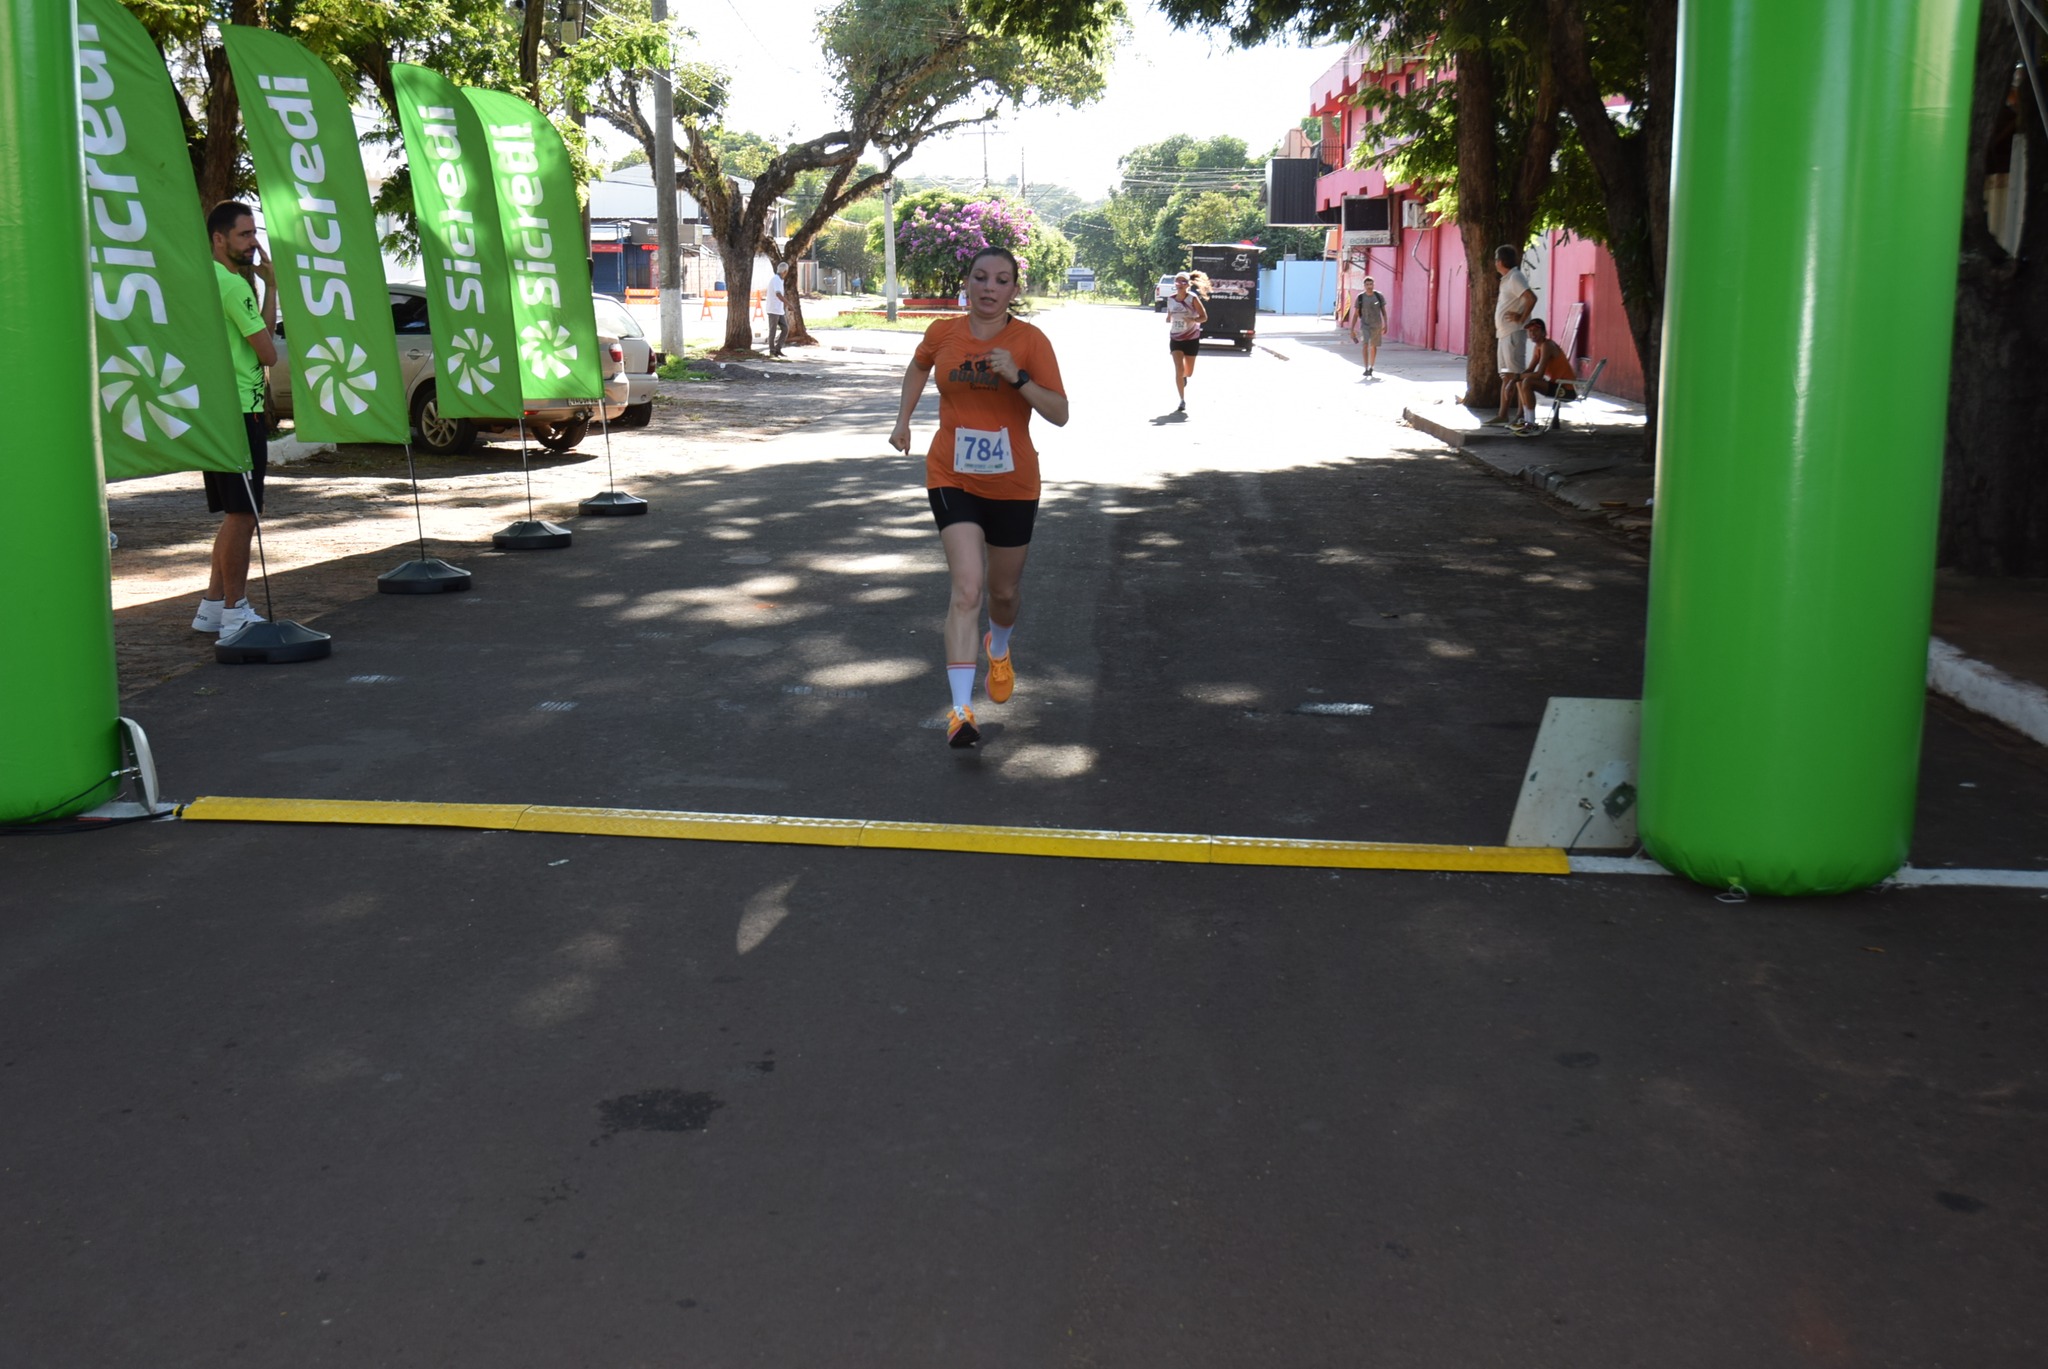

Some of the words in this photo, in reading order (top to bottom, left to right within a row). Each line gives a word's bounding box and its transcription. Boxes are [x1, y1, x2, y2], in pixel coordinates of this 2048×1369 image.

[258, 75, 355, 321] Sicredi
[417, 105, 486, 314] Sicredi
[488, 122, 562, 309] Sicredi
[964, 435, 1004, 462] 784
